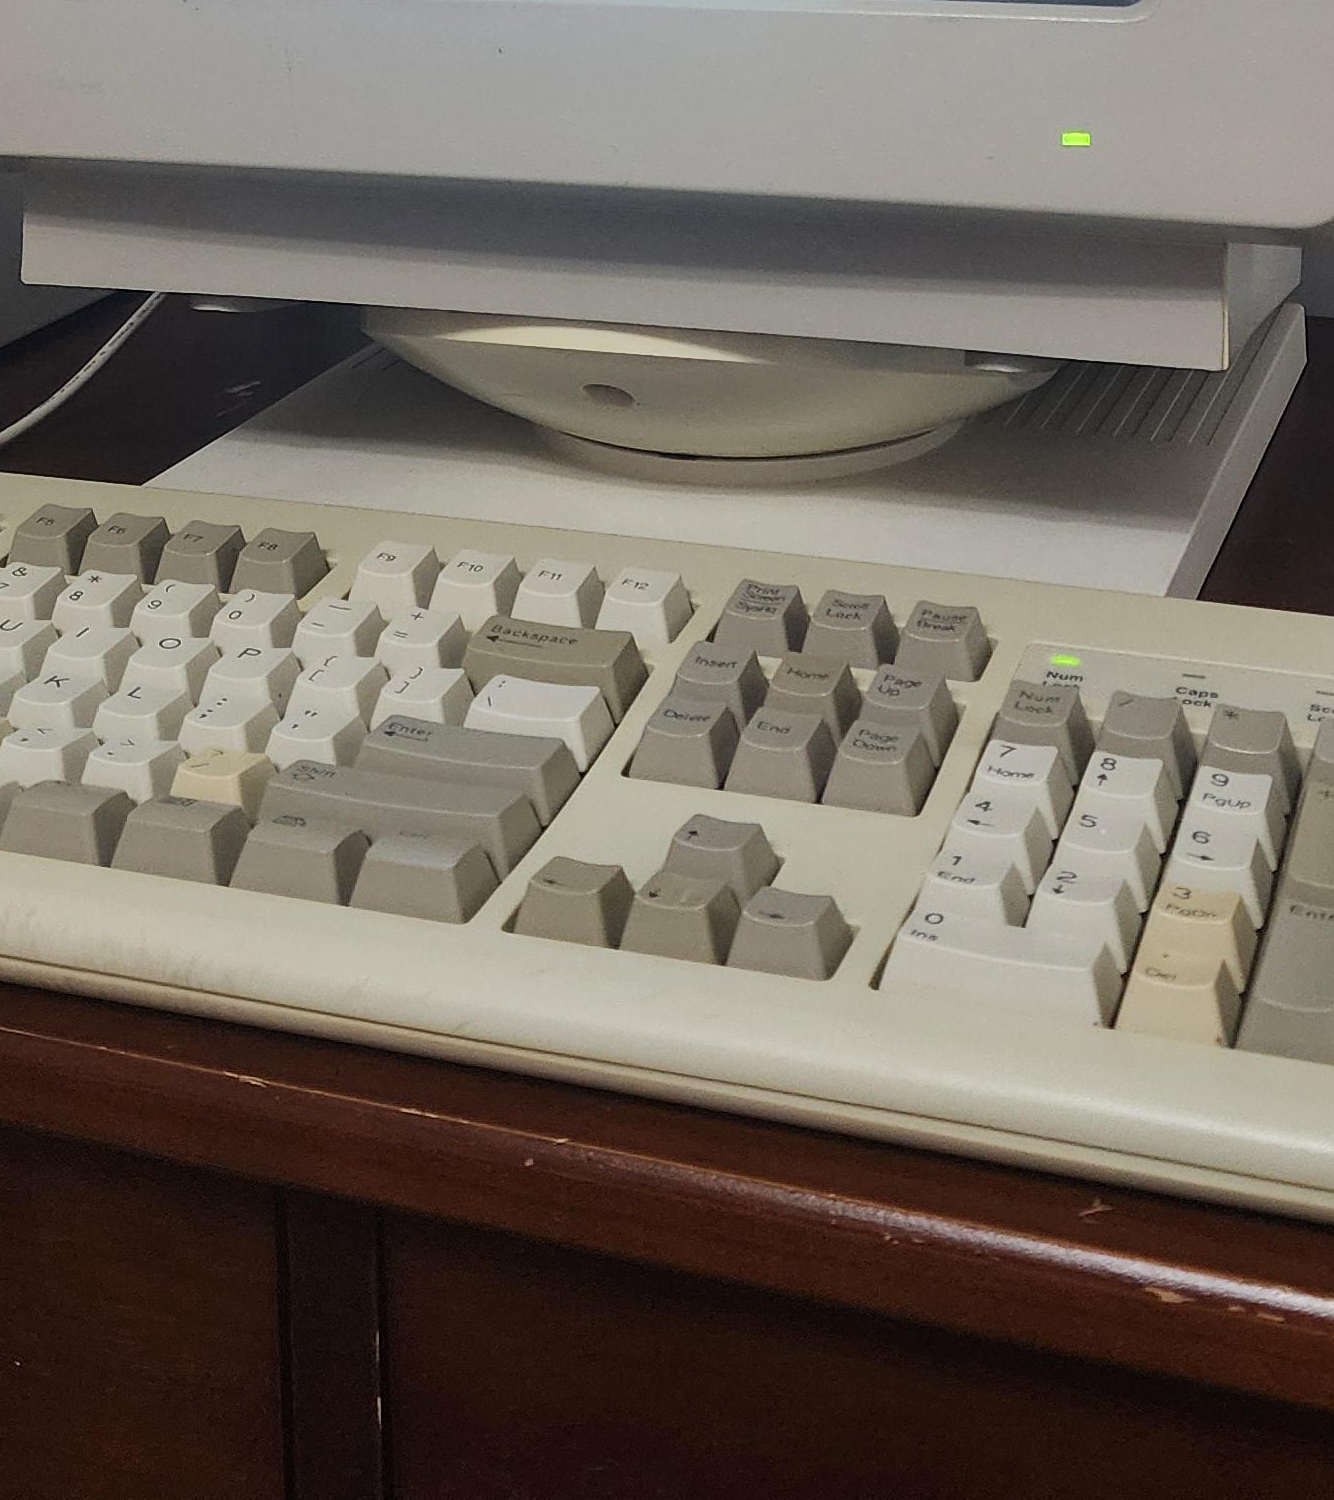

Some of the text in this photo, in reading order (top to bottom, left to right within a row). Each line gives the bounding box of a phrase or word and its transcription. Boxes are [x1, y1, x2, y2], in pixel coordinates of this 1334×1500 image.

[376, 552, 397, 563] F9
[456, 560, 485, 573] F10
[537, 569, 564, 581] F11
[68, 590, 85, 602] 8
[146, 599, 164, 611] 9
[489, 623, 580, 646] Backspace
[237, 647, 262, 659] P
[693, 654, 739, 669] Insert
[785, 667, 830, 680] Home
[1045, 670, 1084, 683] Num
[43, 675, 70, 688] K
[882, 674, 923, 690] Page
[127, 686, 142, 700] L
[878, 684, 901, 696] Up
[1175, 686, 1220, 699] Caps
[663, 708, 712, 723] Delete
[756, 720, 792, 735] End
[858, 728, 901, 743] Page
[998, 744, 1018, 758] 7
[1100, 757, 1118, 771] 8
[986, 764, 1036, 780] Home
[1210, 773, 1229, 787] 9
[975, 800, 993, 812] 4
[1202, 793, 1253, 810] PgUp
[1078, 814, 1100, 828] 5
[1191, 831, 1212, 845] 6
[1056, 871, 1078, 884] 2
[1172, 886, 1193, 900] 3
